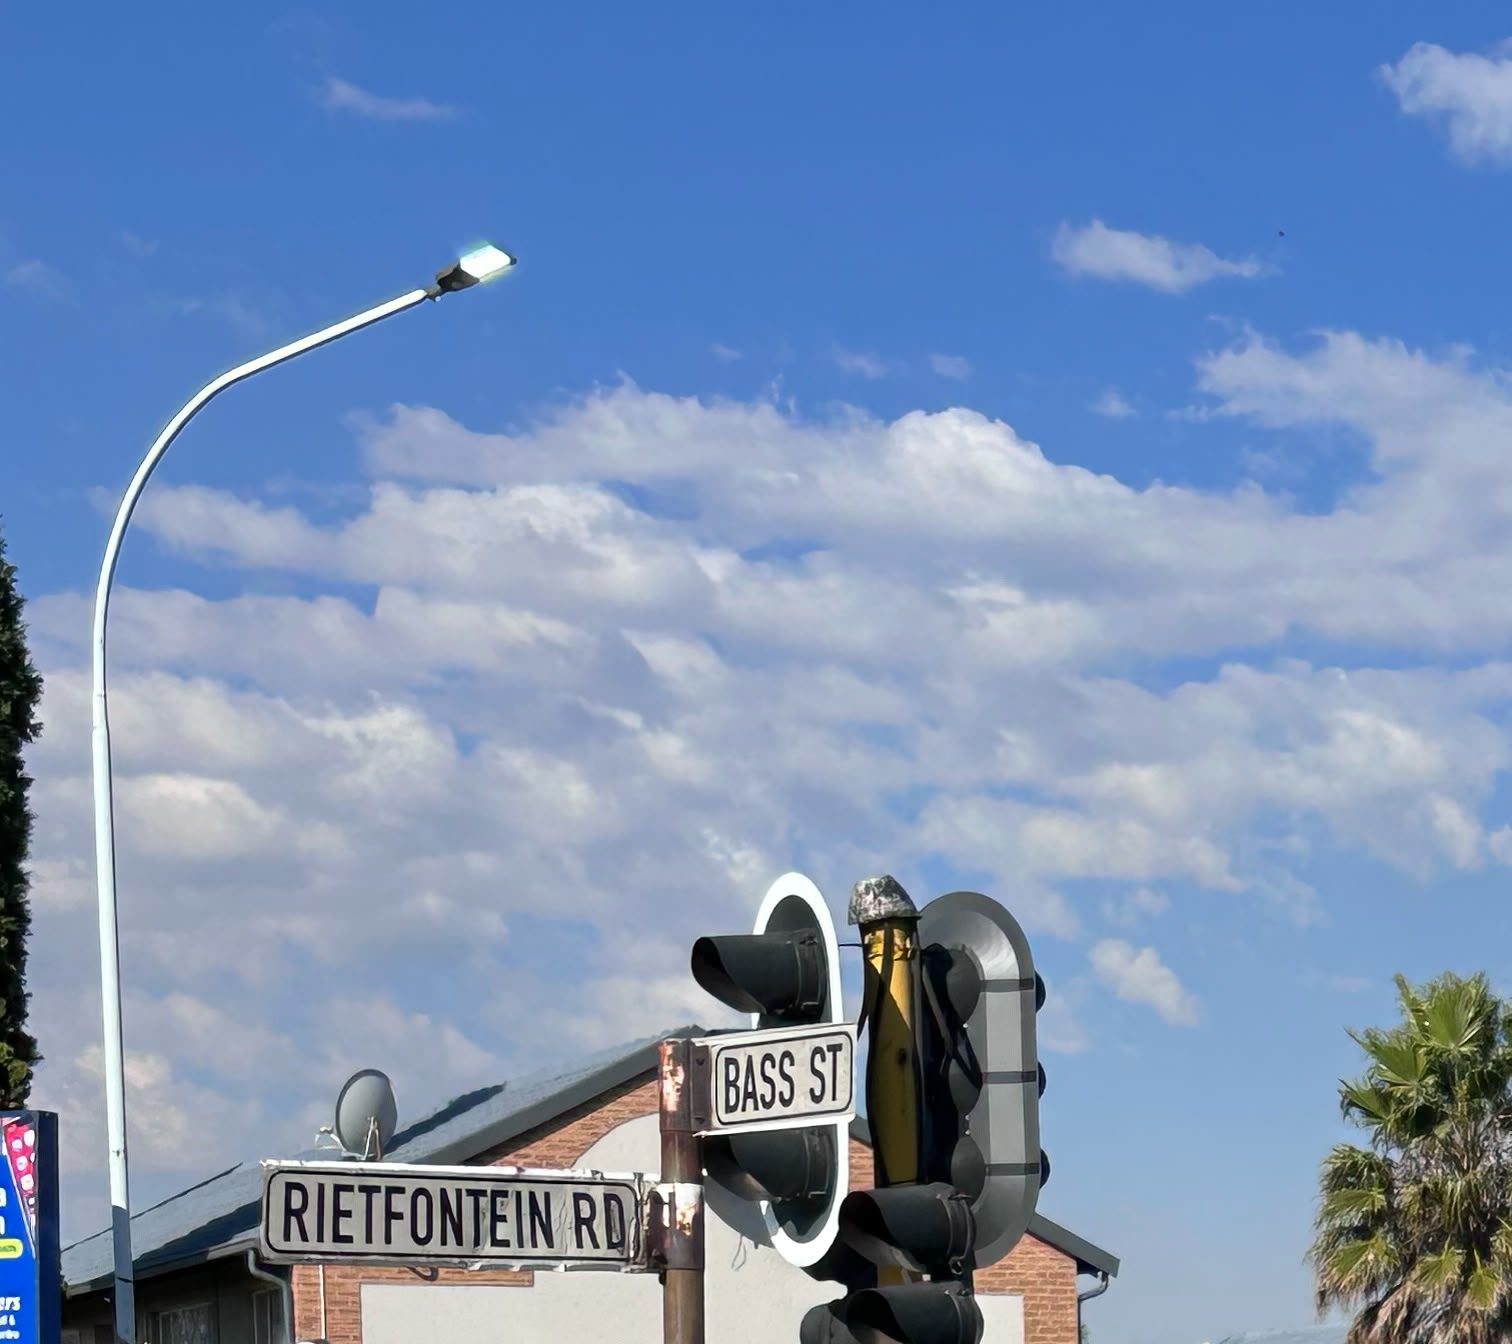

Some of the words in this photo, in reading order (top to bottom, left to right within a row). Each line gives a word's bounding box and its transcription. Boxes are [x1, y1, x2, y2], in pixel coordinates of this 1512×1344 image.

[724, 1050, 795, 1114] BASS
[809, 1043, 844, 1105] ST
[283, 1181, 555, 1249] RIETFONTEIN
[573, 1192, 627, 1255] RD
